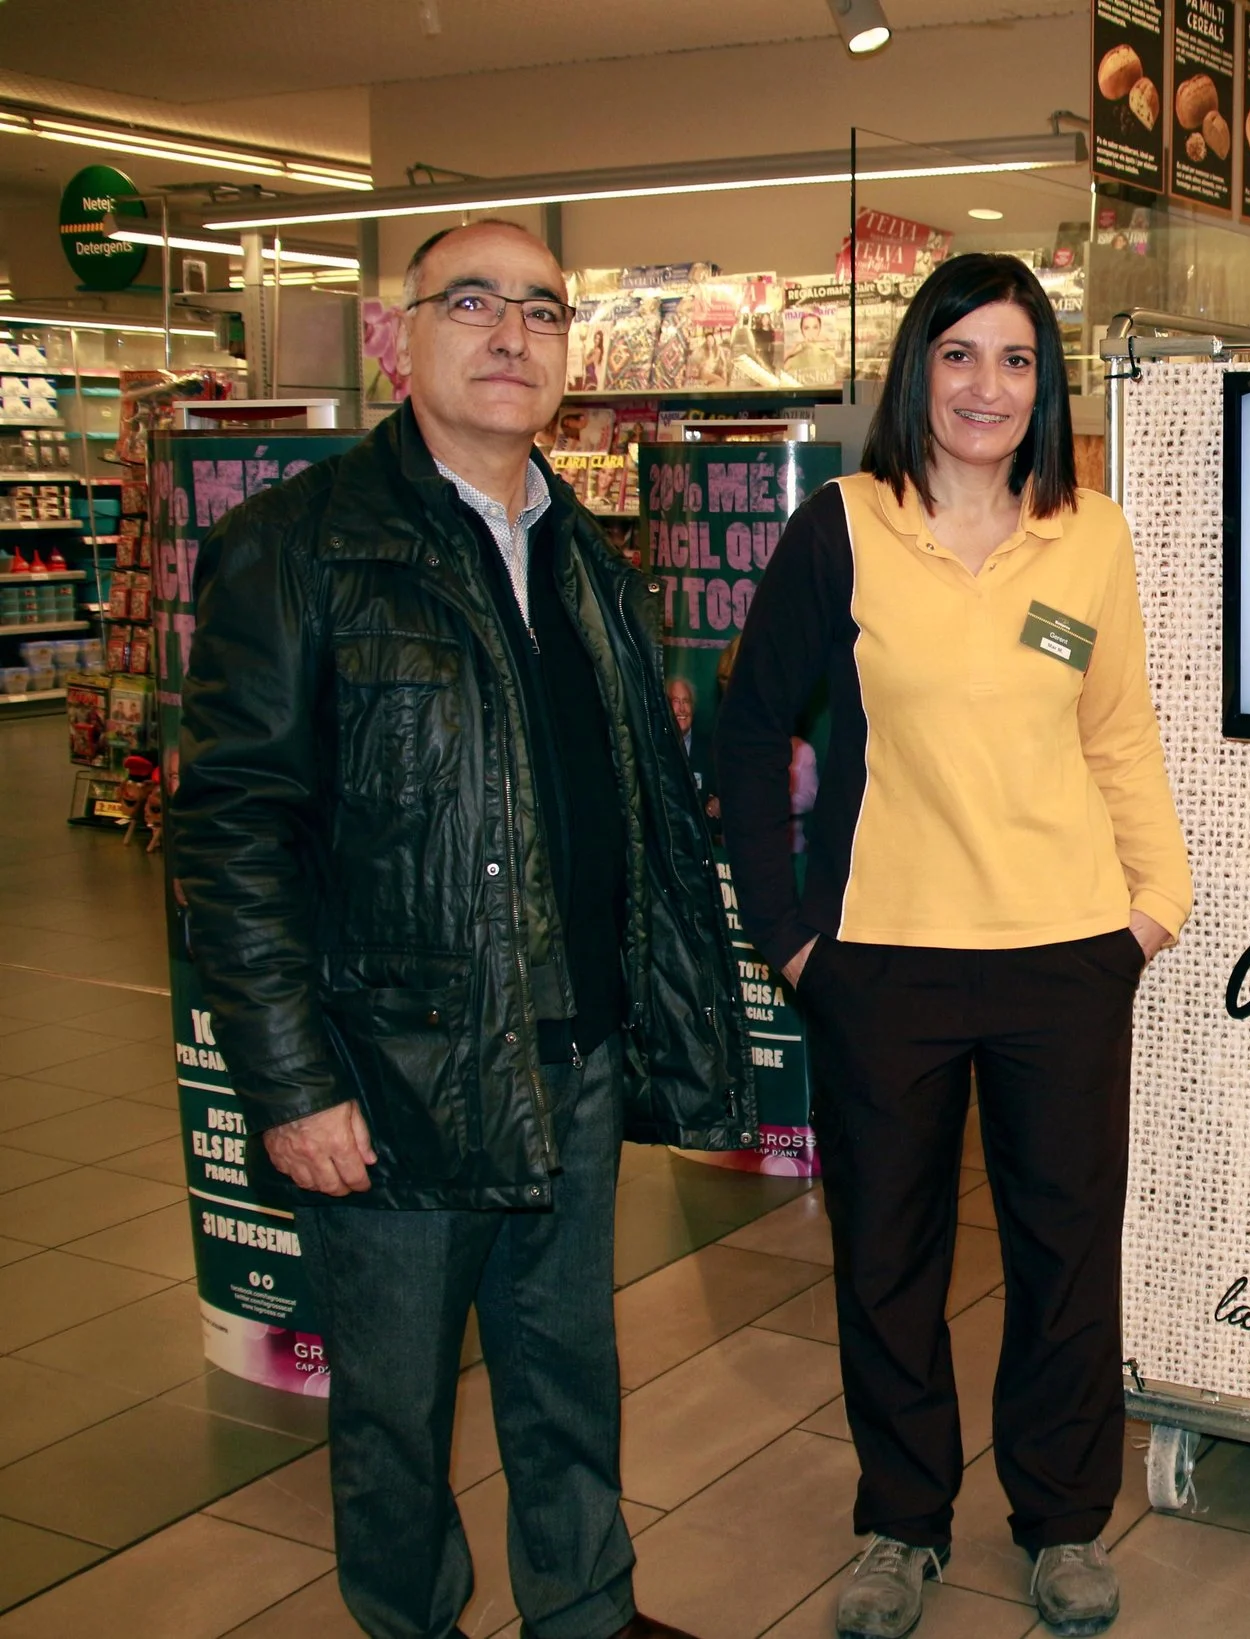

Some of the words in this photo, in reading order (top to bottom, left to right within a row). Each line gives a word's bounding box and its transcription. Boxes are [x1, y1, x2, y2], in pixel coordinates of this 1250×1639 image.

[1187, 12, 1224, 43] CEREALS
[867, 212, 917, 242] TELVA
[75, 240, 133, 256] Detergents
[854, 282, 875, 294] laire
[555, 456, 587, 469] CLARA
[592, 454, 624, 468] CLARA
[650, 463, 703, 512] 20%
[707, 452, 805, 515] MÉS
[726, 521, 786, 573] QU
[738, 961, 769, 981] TOTS
[741, 981, 772, 1006] ICIS
[773, 987, 785, 1007] A
[746, 1006, 774, 1021] CIALS
[176, 1042, 199, 1067] PER
[198, 1049, 229, 1072] CAD
[192, 1130, 223, 1160] ELS
[223, 1136, 247, 1165] BE
[772, 1149, 798, 1157] D'ANY
[202, 1211, 217, 1237] 31
[217, 1214, 236, 1242] DE
[296, 1361, 314, 1372] CAP
